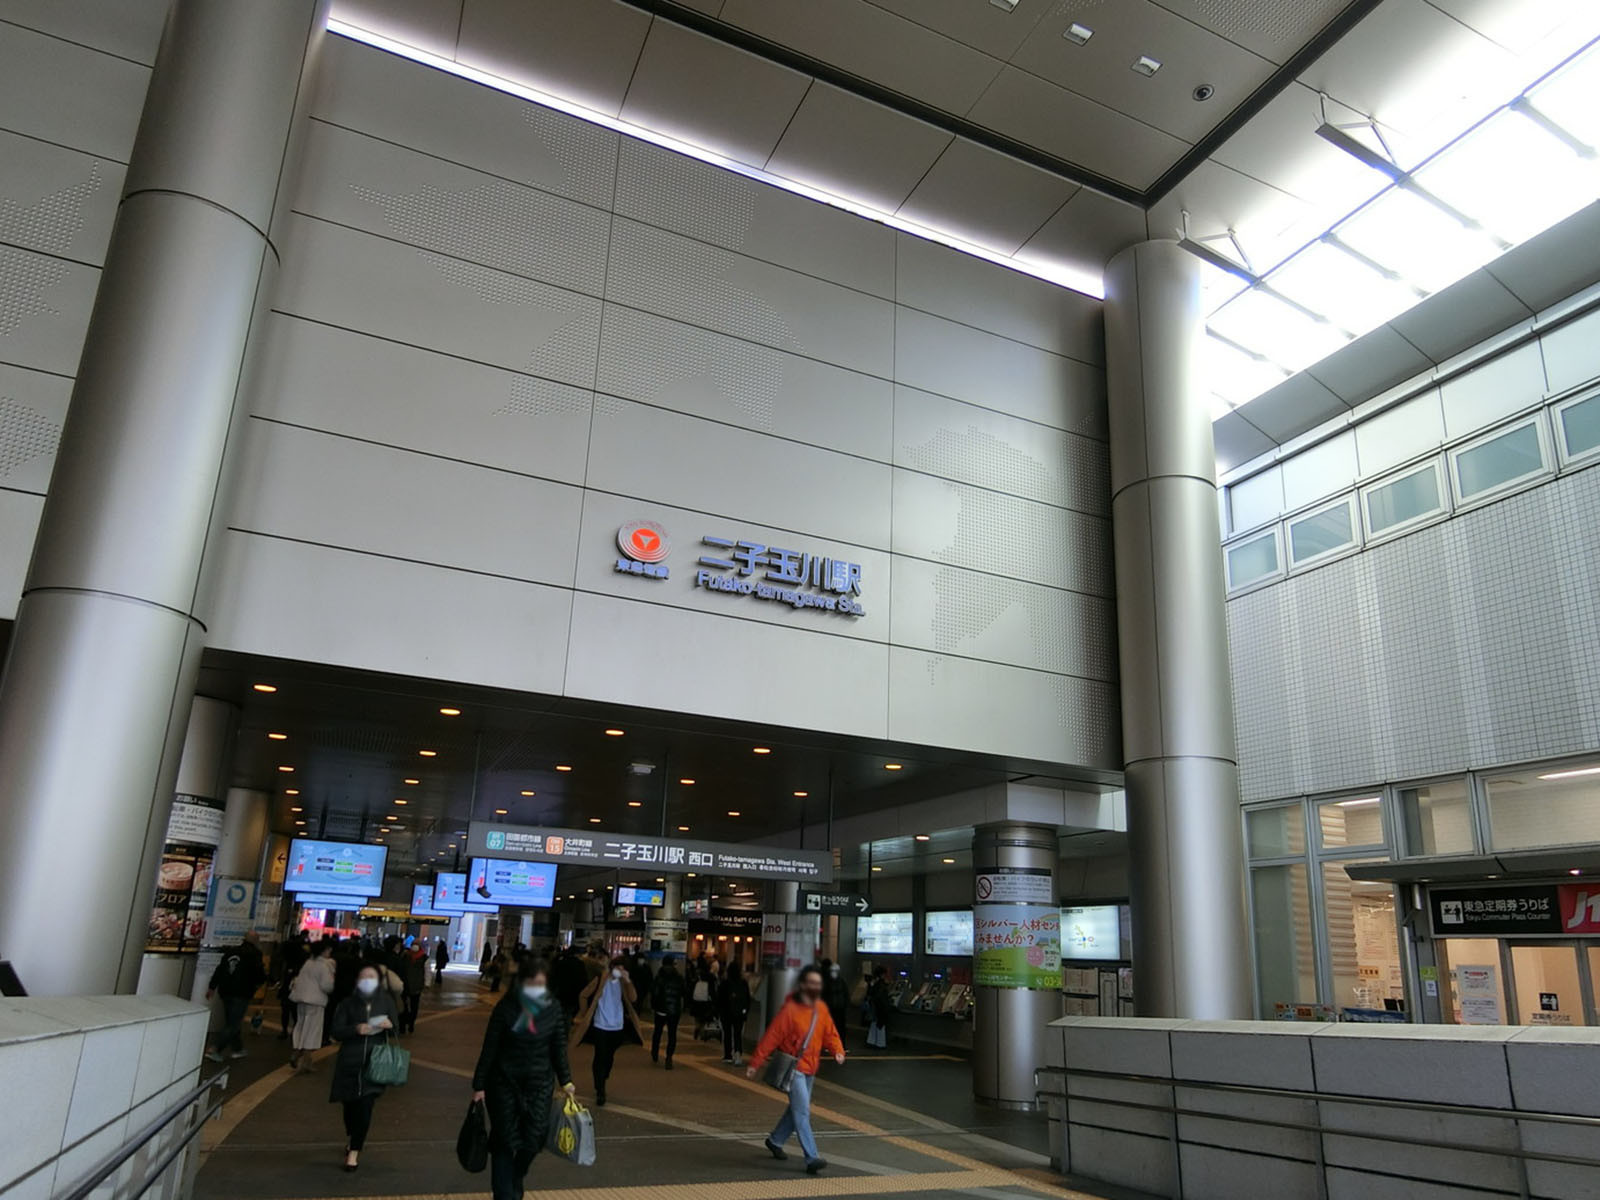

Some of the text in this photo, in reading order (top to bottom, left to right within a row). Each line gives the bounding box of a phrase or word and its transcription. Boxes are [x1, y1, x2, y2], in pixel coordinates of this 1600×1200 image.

[698, 535, 862, 596] 二子玉川駅
[695, 570, 866, 617] Futako-tamagawa Sta.
[490, 839, 501, 848] 07
[549, 844, 560, 853] 15
[604, 841, 713, 868] 二子玉川駅 西口
[1464, 897, 1549, 913] 東急定期券うりば
